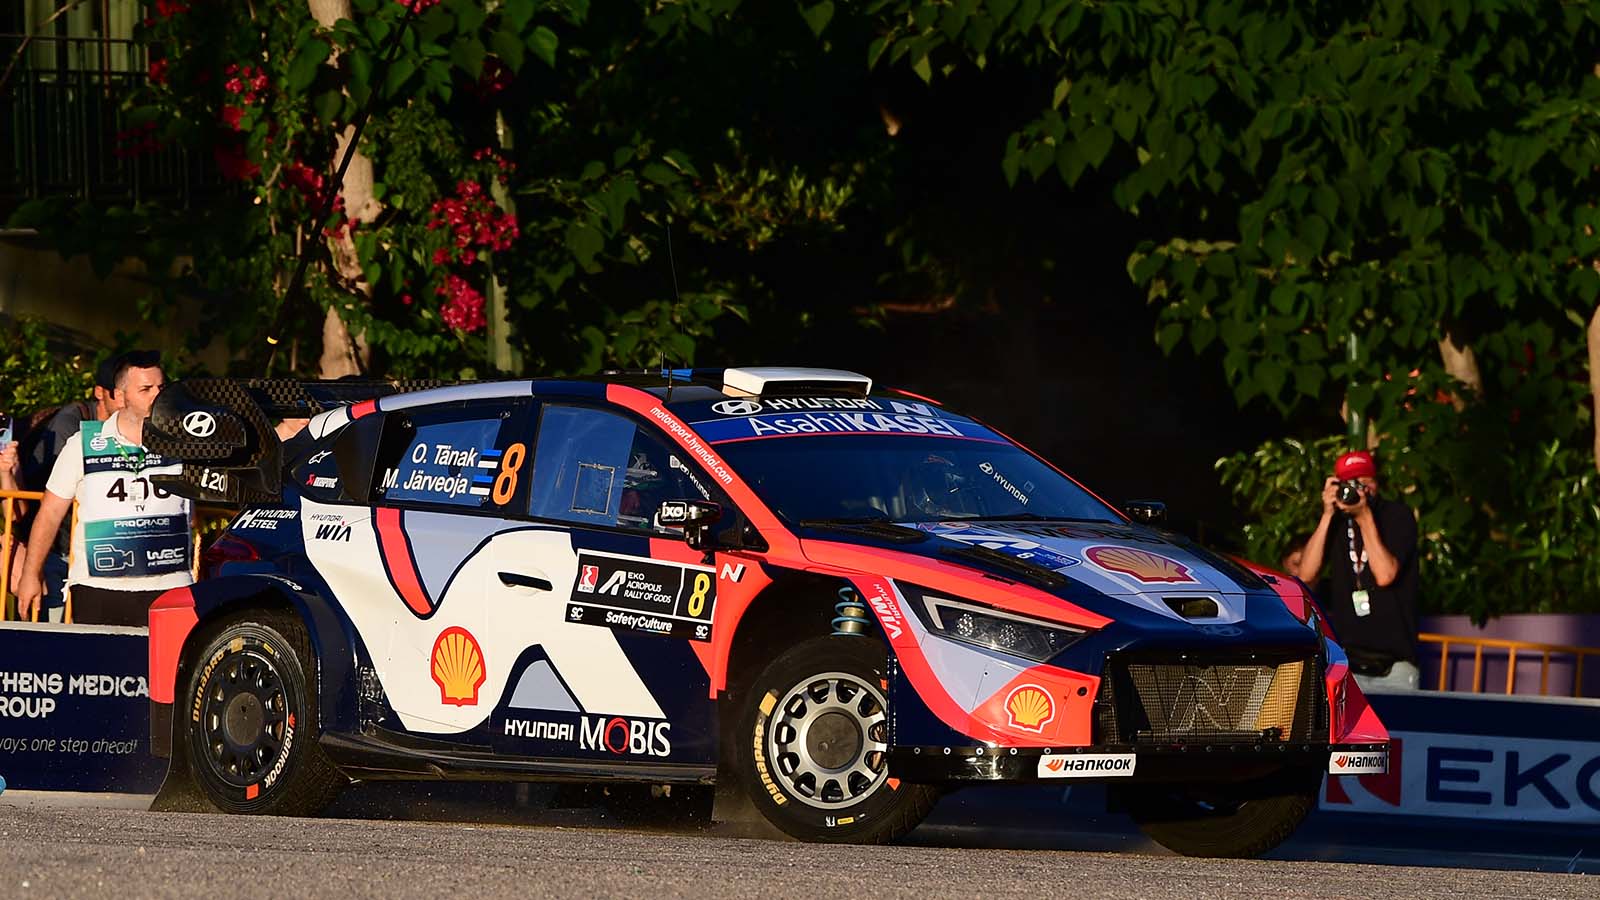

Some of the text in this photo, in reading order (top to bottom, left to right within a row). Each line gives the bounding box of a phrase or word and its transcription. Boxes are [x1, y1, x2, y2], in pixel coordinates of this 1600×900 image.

[765, 397, 883, 411] HYUNDAI
[748, 413, 965, 436] AsahiKASEI
[412, 443, 478, 467] O. Tänak
[650, 407, 734, 485] motorsport.hyundai.com
[381, 467, 468, 498] M. Järveoja
[492, 443, 526, 505] 8
[993, 472, 1029, 505] HYUNDAI
[135, 504, 145, 512] TV
[257, 509, 299, 519] HYUNDAI
[310, 513, 343, 522] HYUNDAI
[249, 519, 279, 530] STEEL
[315, 523, 352, 542] WIA
[626, 580, 662, 592] ACROPOLIS
[627, 572, 645, 581] EKO
[624, 589, 672, 604] RALLY OF GODS
[687, 572, 711, 617] 8
[570, 606, 583, 618] SC
[605, 611, 673, 632] SafetyCulture
[696, 625, 709, 637] SC
[0, 672, 64, 695] HENS
[504, 718, 575, 741] HYUNDAI
[579, 715, 671, 757] MOBIS
[31, 738, 57, 752] one
[59, 737, 88, 756] step
[92, 738, 138, 755] ahead!
